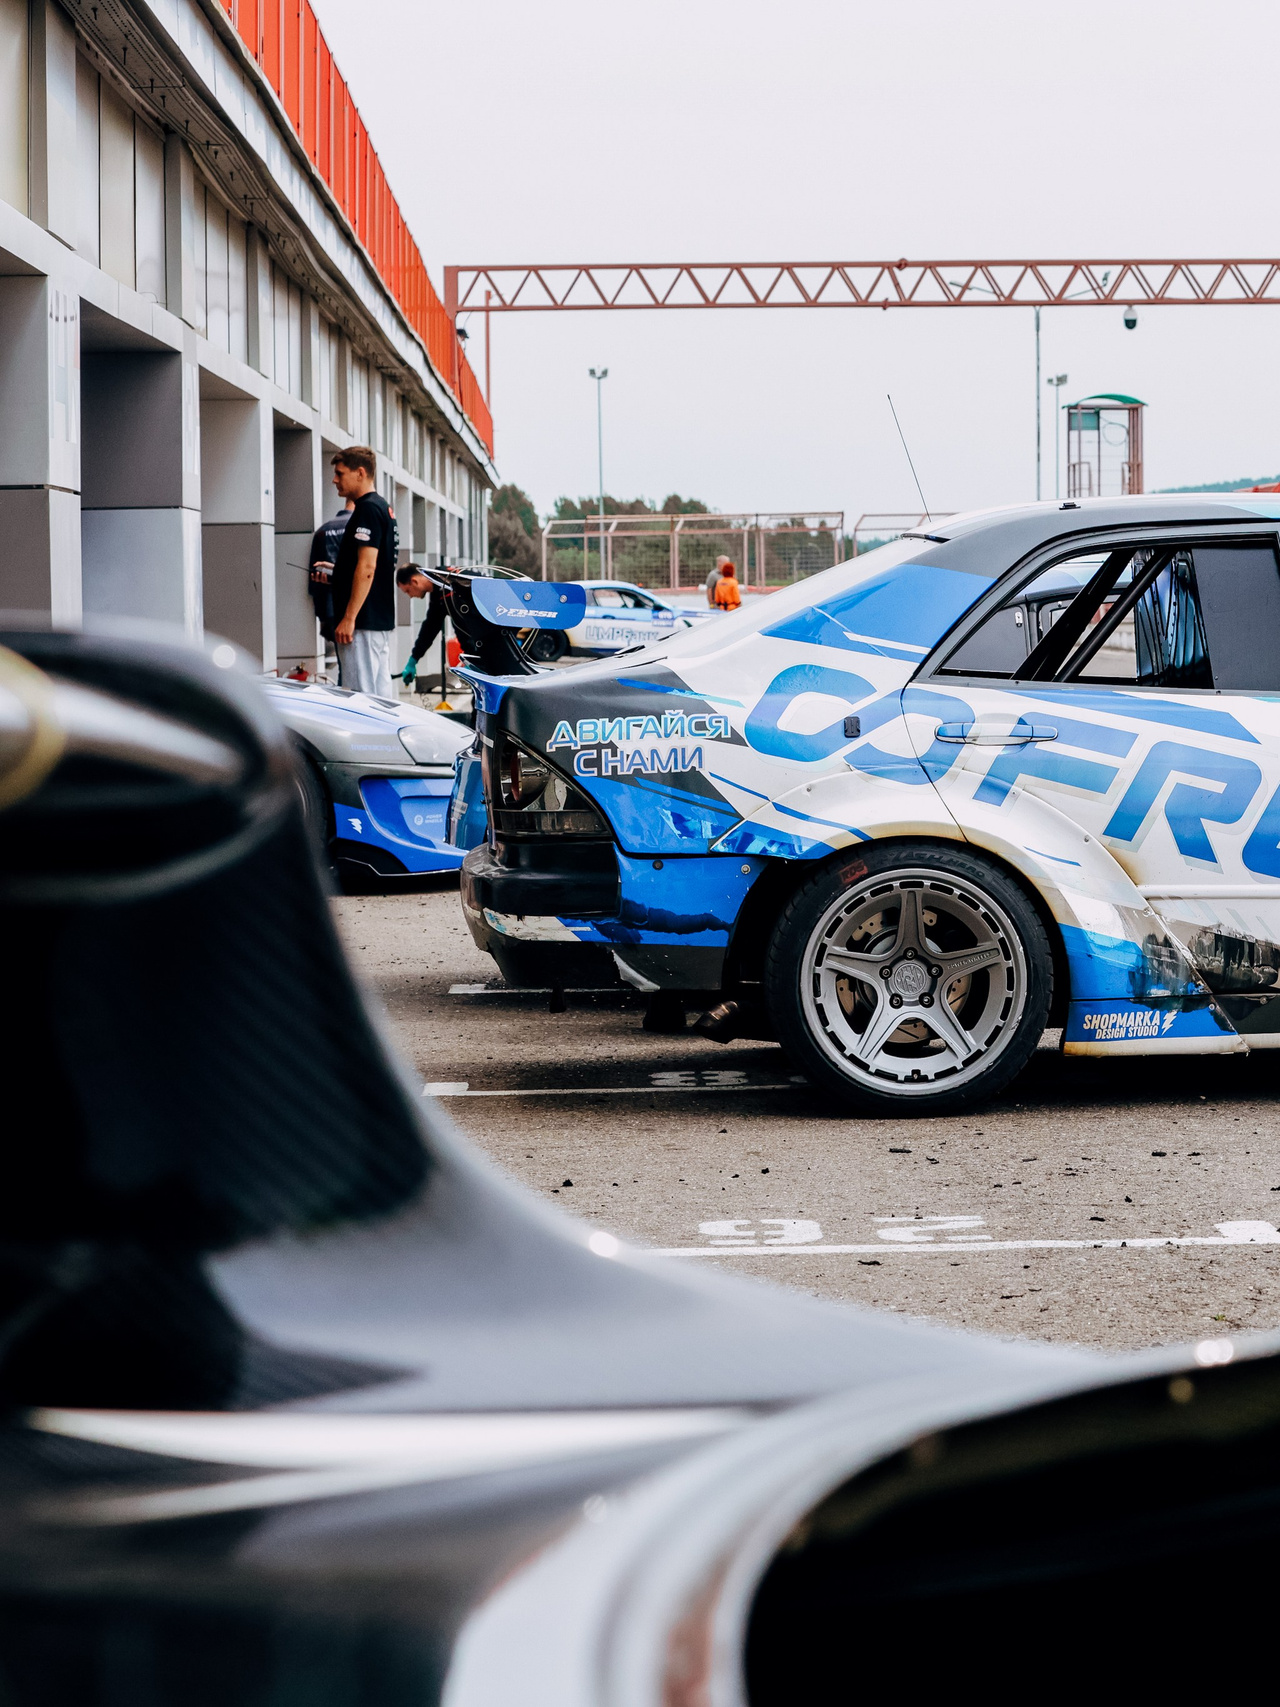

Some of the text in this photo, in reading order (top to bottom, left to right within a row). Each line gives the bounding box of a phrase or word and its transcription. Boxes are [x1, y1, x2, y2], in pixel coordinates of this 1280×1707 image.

[548, 711, 731, 751] ДВИГАЙСЯ
[1083, 1010, 1160, 1030] SHOPMARKA
[1095, 1025, 1159, 1039] DESIGN STUDIO
